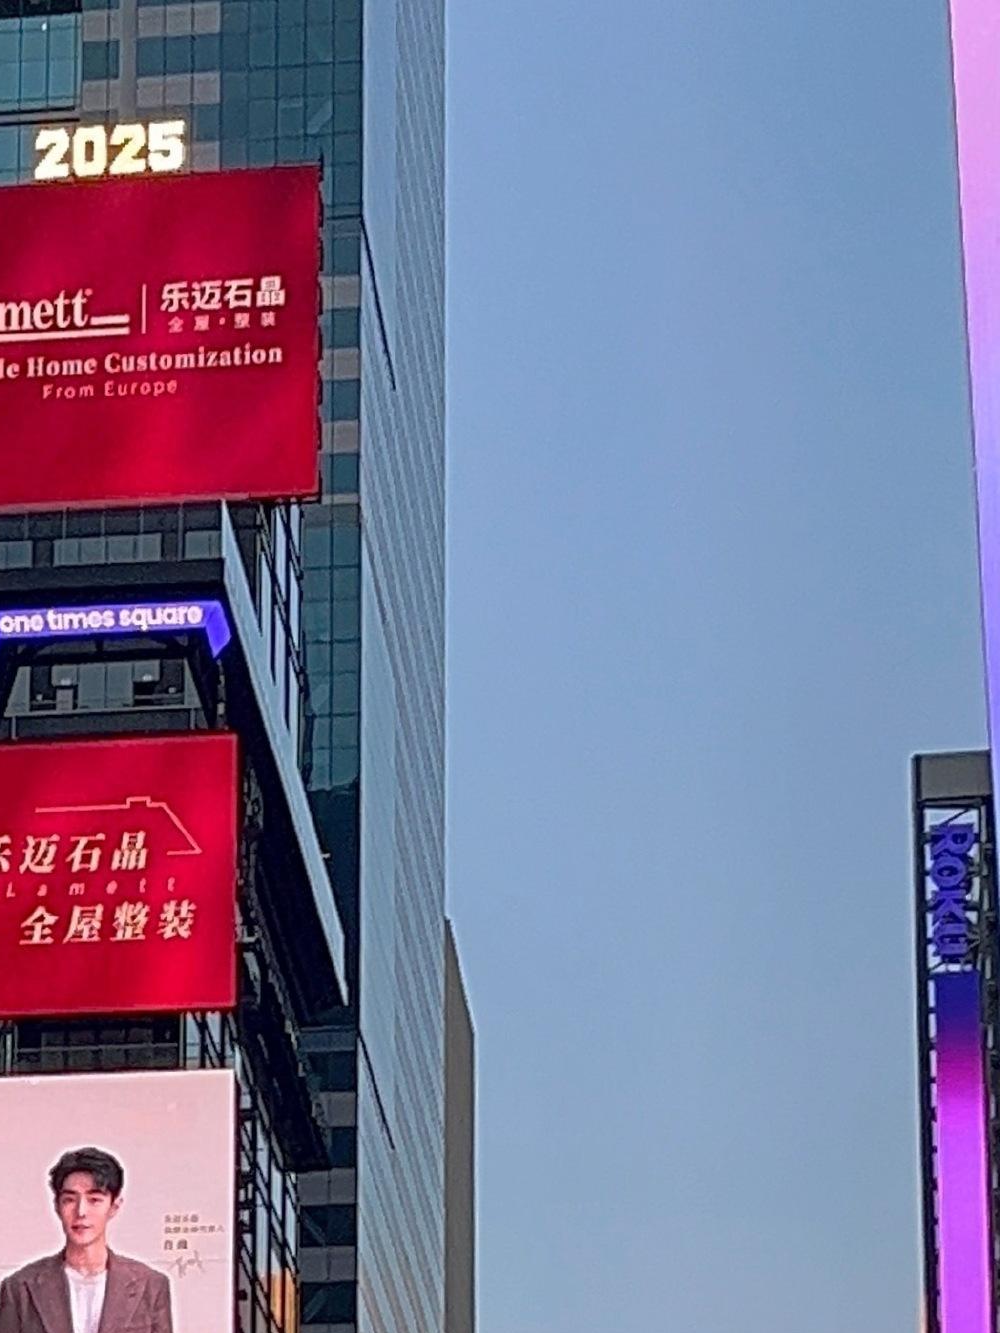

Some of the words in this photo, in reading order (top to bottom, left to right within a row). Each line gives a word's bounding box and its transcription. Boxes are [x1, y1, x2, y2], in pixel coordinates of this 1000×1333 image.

[34, 119, 186, 180] 2025
[160, 276, 285, 312] 乐迈石晶
[26, 356, 97, 378] Home
[104, 342, 283, 374] Customization
[43, 384, 95, 399] From
[104, 379, 178, 397] Europe
[0, 614, 44, 633] one
[47, 607, 115, 631] times
[119, 605, 203, 631] square
[929, 822, 976, 957] ROKU
[19, 899, 198, 945] 全屋整装
